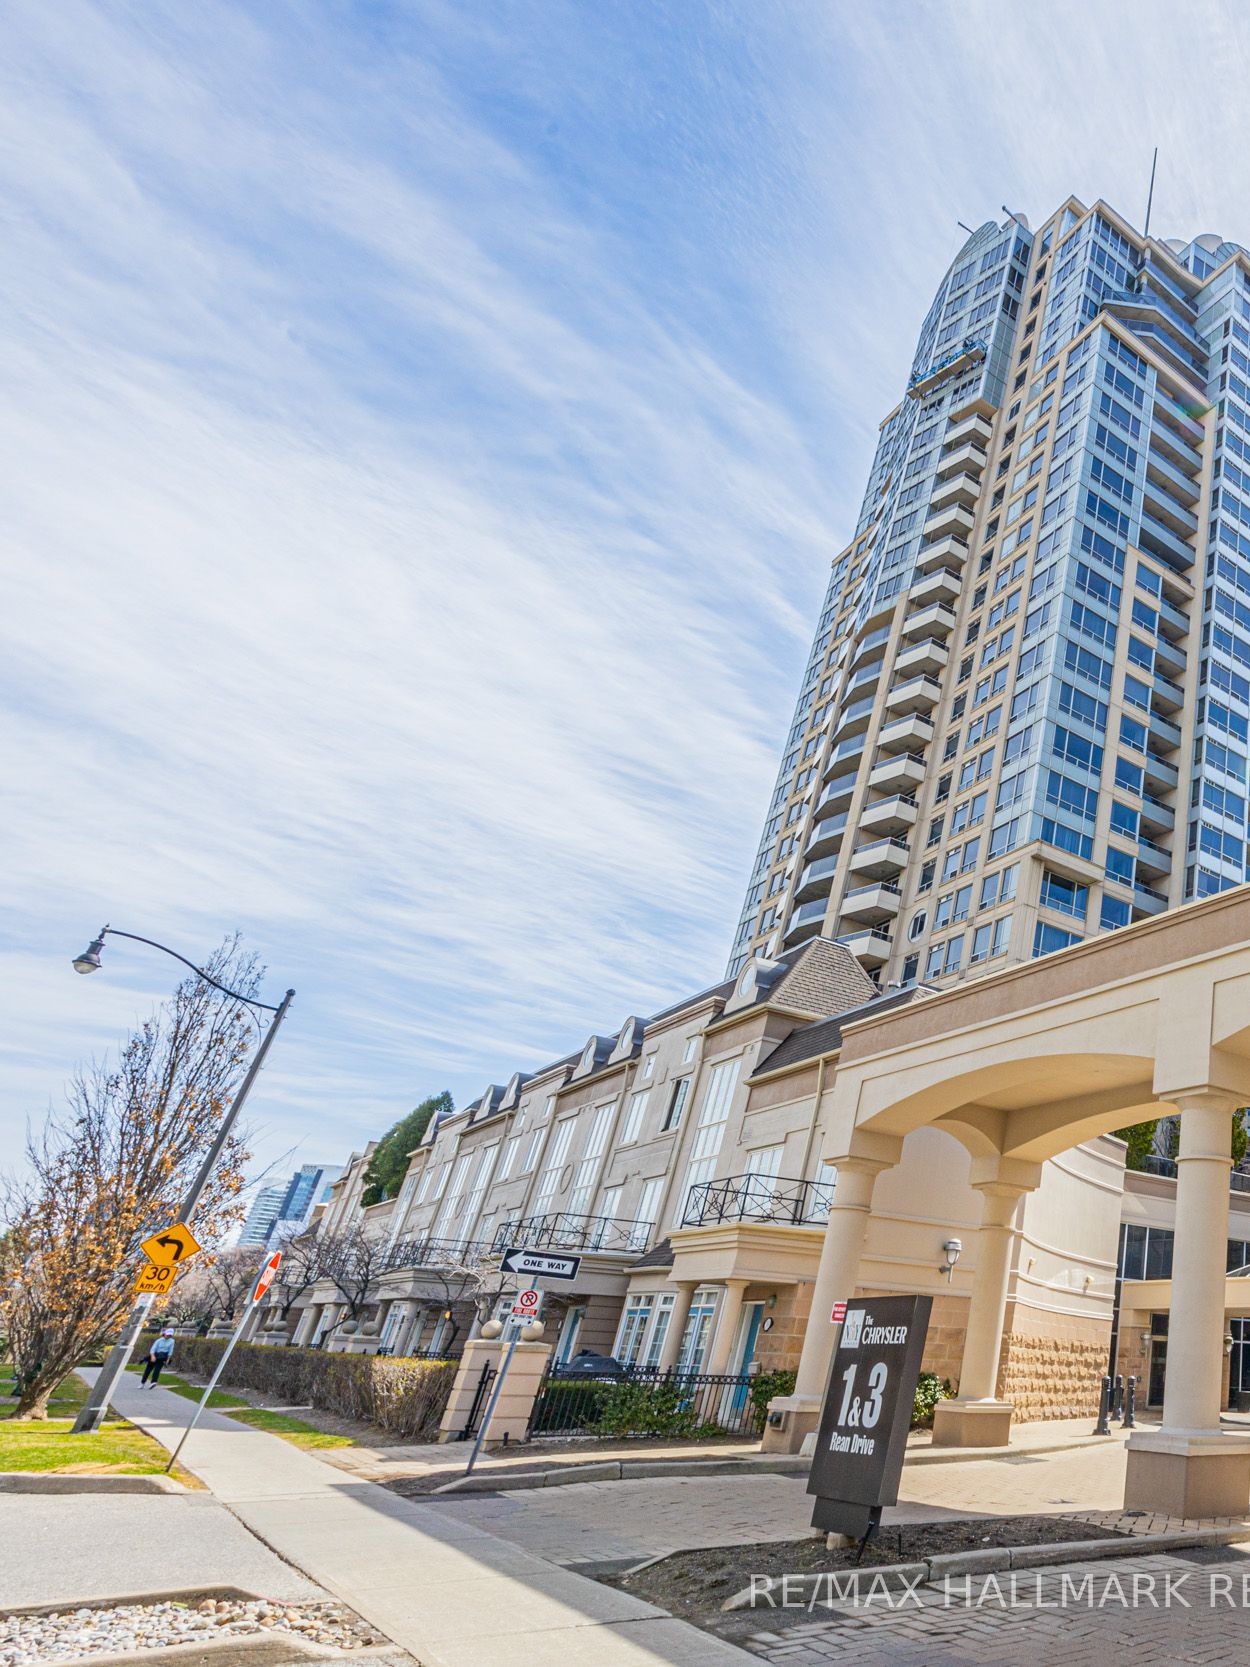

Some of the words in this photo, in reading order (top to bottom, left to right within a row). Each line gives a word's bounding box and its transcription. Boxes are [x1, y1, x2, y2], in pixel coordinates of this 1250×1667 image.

[523, 1259, 543, 1267] ONE
[547, 1261, 567, 1270] WAY
[146, 1266, 170, 1281] 30
[140, 1282, 165, 1291] km/h
[865, 1315, 874, 1325] The
[861, 1326, 907, 1345] CHRYSLER
[829, 1431, 851, 1453] Rean
[850, 1433, 875, 1456] Drive
